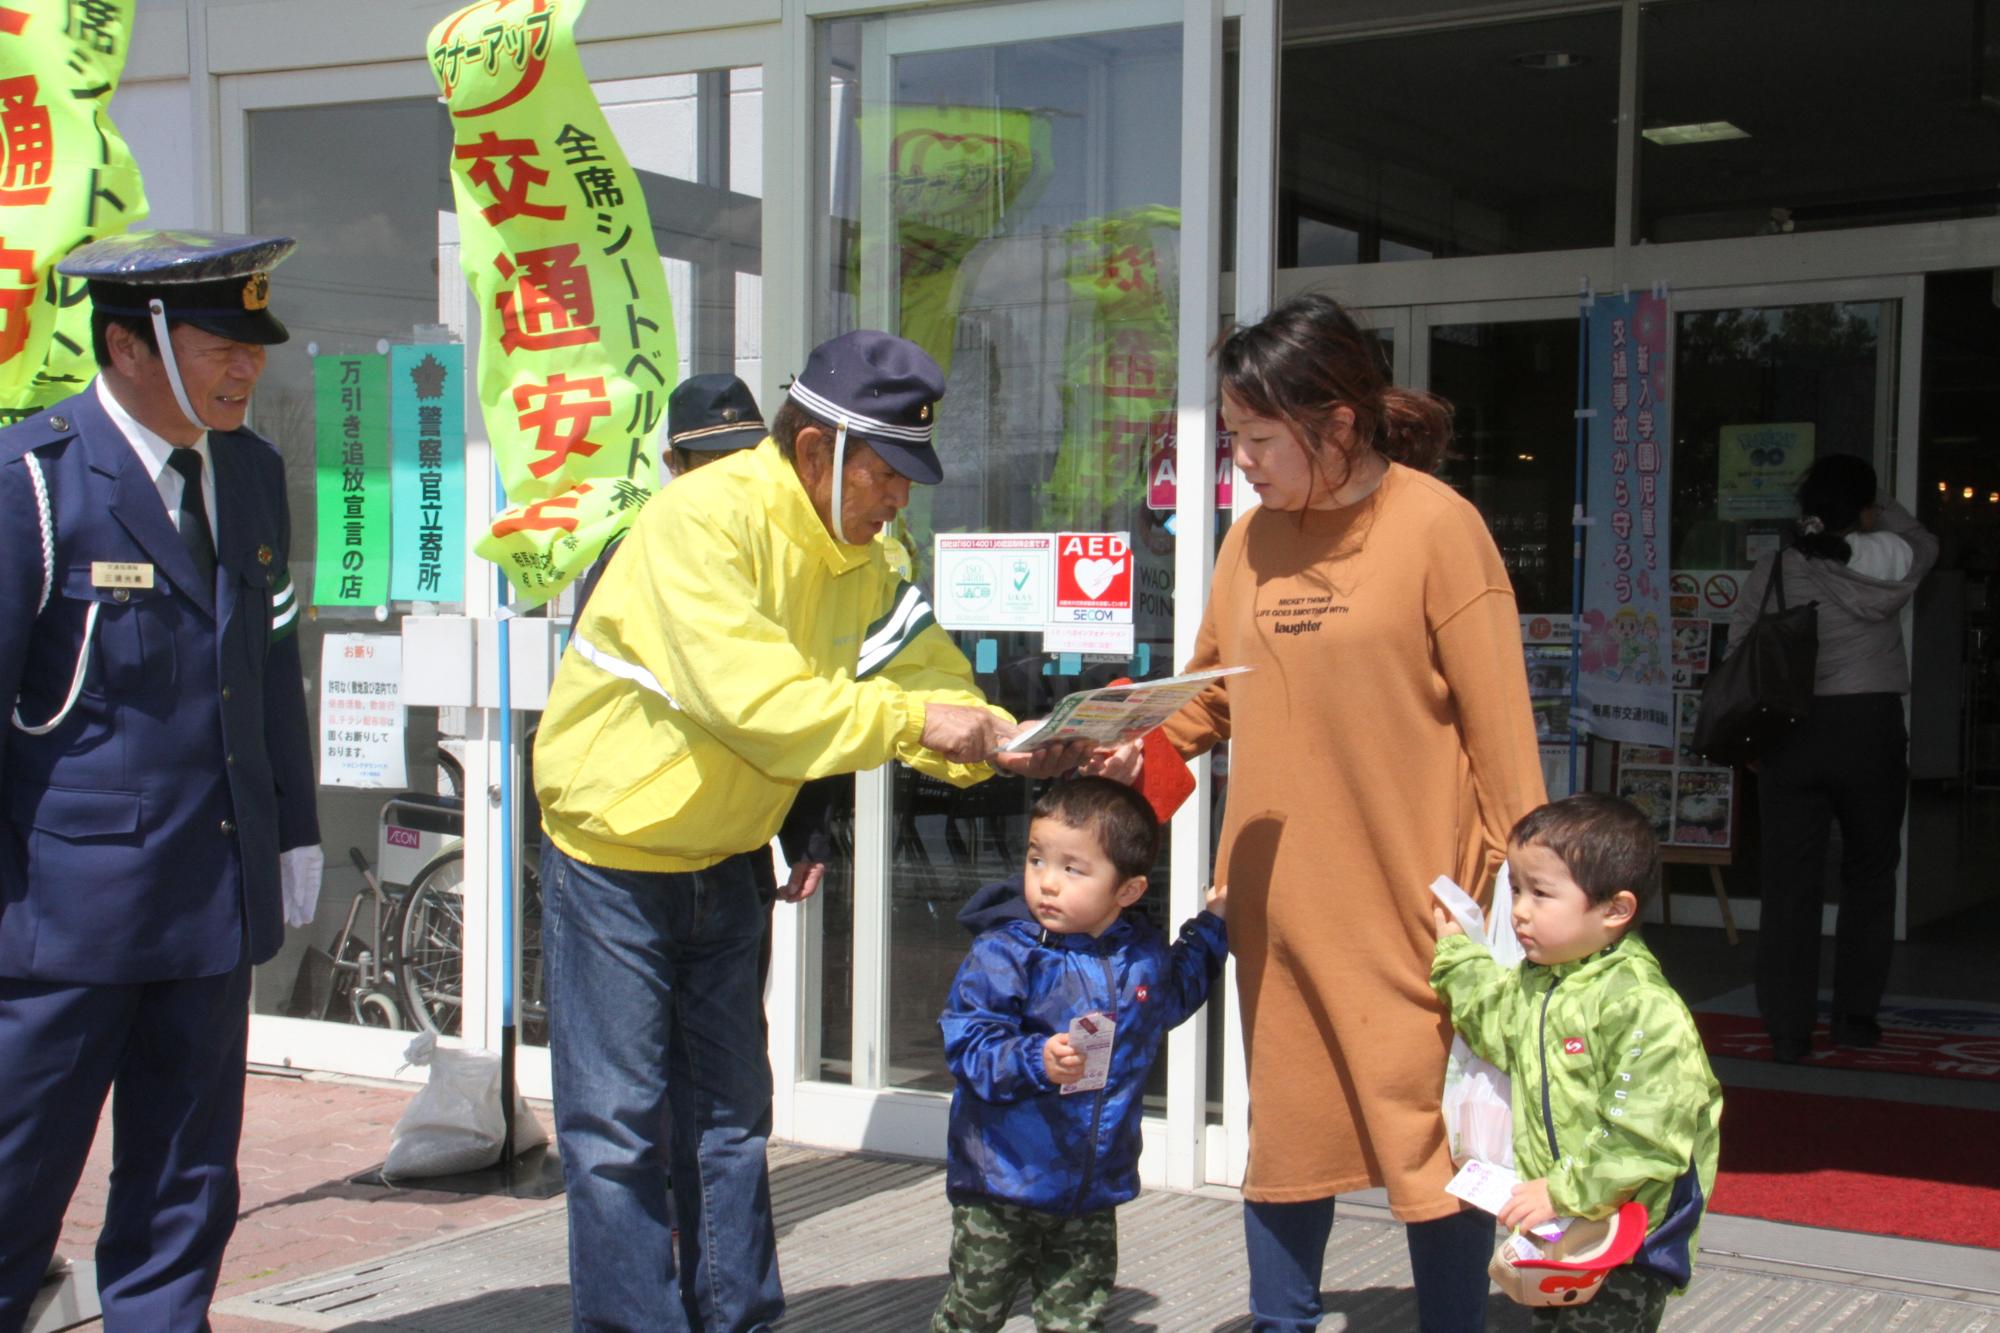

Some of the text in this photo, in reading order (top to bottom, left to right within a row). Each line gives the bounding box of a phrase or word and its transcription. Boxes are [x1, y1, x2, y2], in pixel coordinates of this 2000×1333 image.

[434, 6, 555, 84] マナーアップ
[339, 360, 365, 599] 万引き追放宣言の店
[1611, 318, 1633, 601] 交通事故から守ろう
[417, 406, 443, 593] 警察官立寄所
[1063, 537, 1127, 556] AED
[1073, 609, 1113, 622] SECOM
[1274, 620, 1322, 636] laughter
[344, 646, 374, 659] お断り
